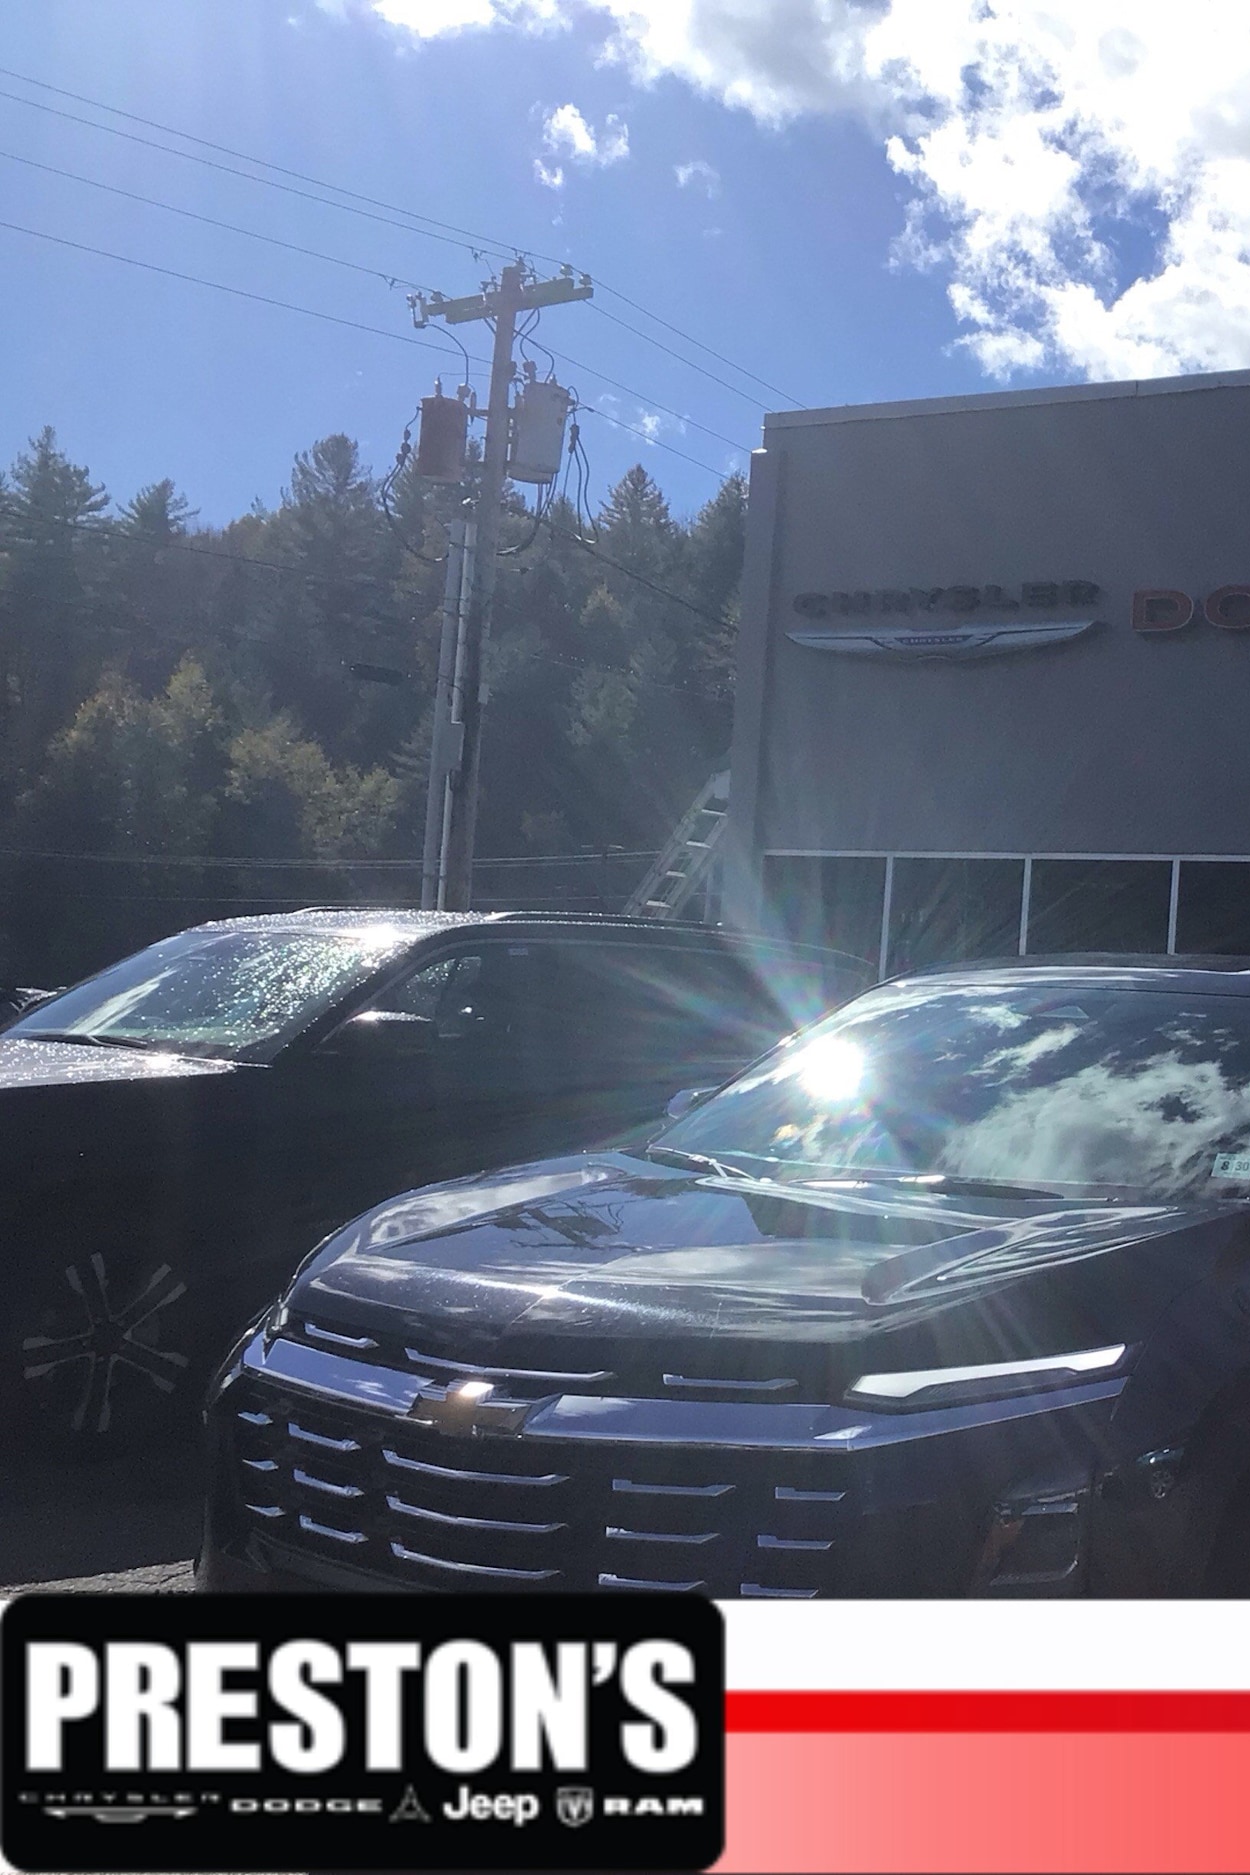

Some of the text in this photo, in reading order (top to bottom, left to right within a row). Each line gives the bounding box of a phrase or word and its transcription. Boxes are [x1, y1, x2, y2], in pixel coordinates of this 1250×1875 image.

[791, 580, 1101, 614] CHRYSLER
[1220, 1160, 1250, 1172] 8 30
